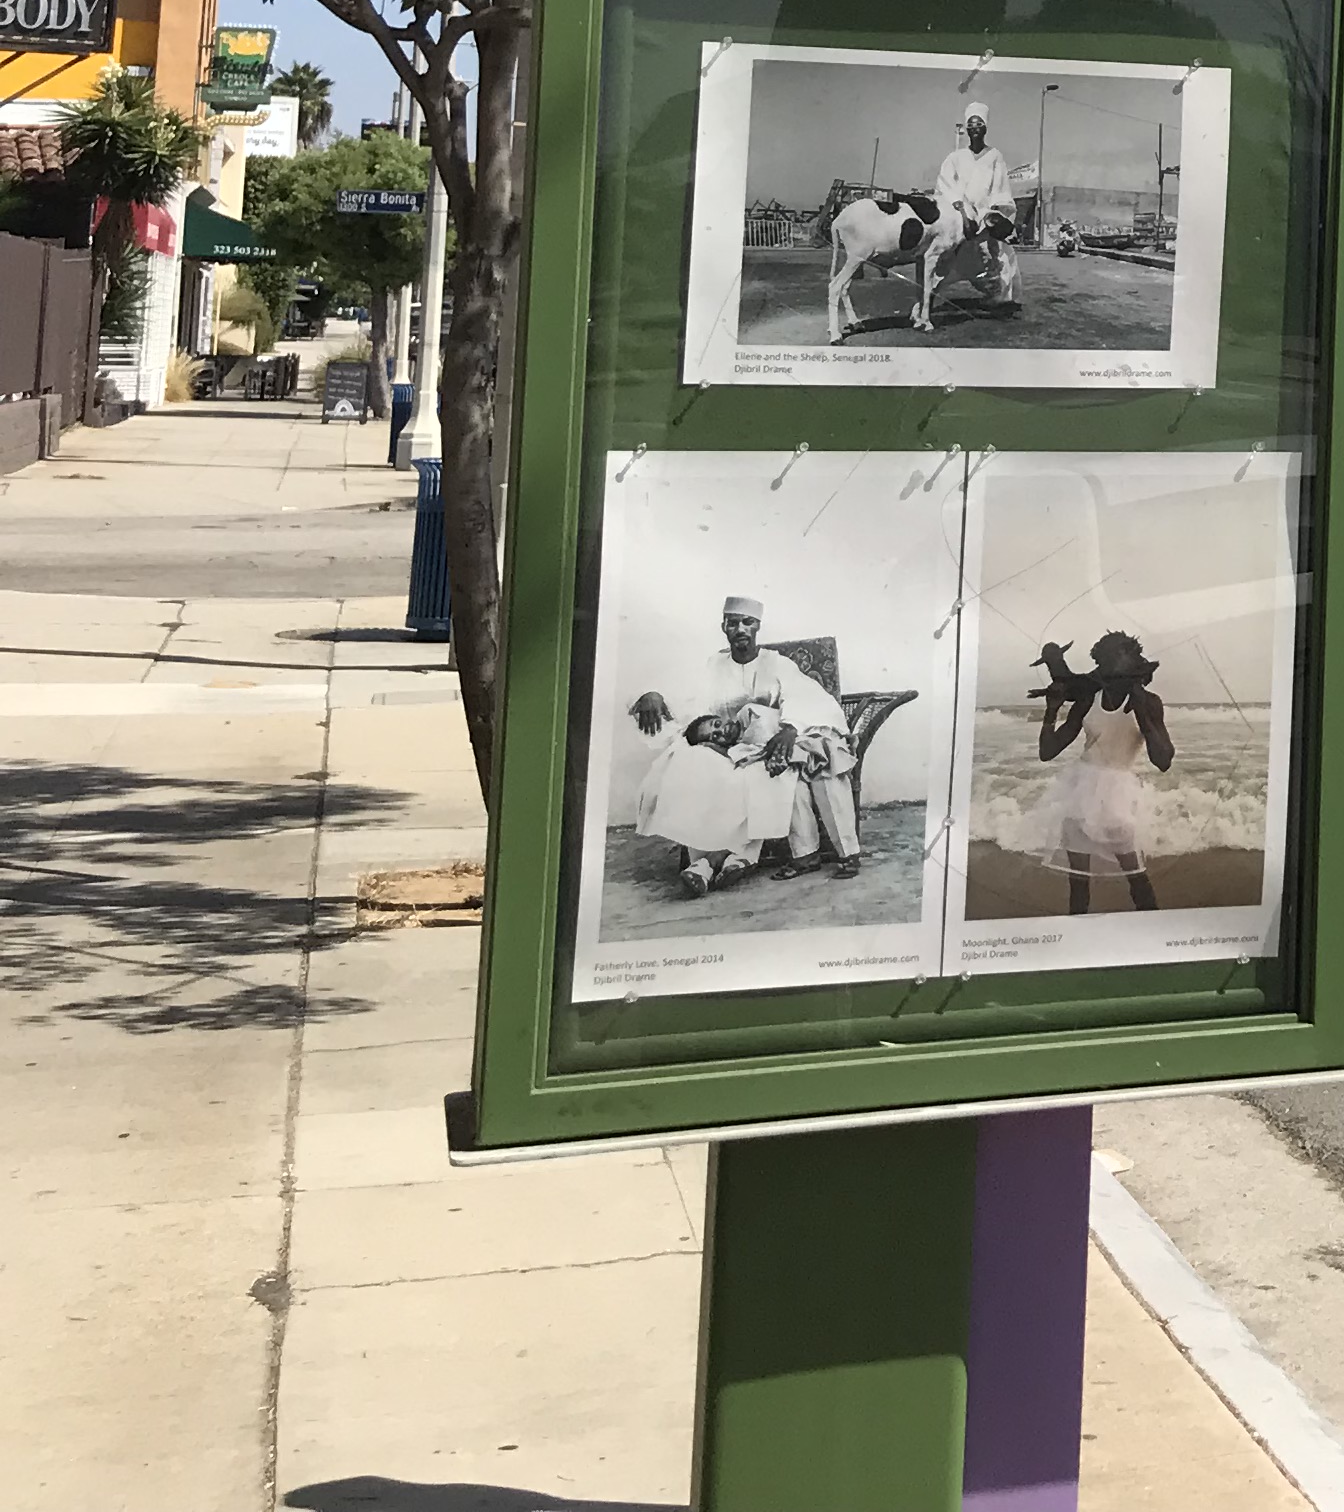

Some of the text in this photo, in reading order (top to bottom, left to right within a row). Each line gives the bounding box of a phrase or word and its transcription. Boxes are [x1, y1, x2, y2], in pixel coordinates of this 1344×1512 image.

[340, 190, 417, 205] Sierra Bonita
[212, 244, 231, 255] 323
[233, 245, 251, 256] 503
[783, 352, 798, 362] the
[594, 960, 634, 972] Fatherly
[662, 955, 699, 968] Senegal
[701, 953, 725, 965] 2014
